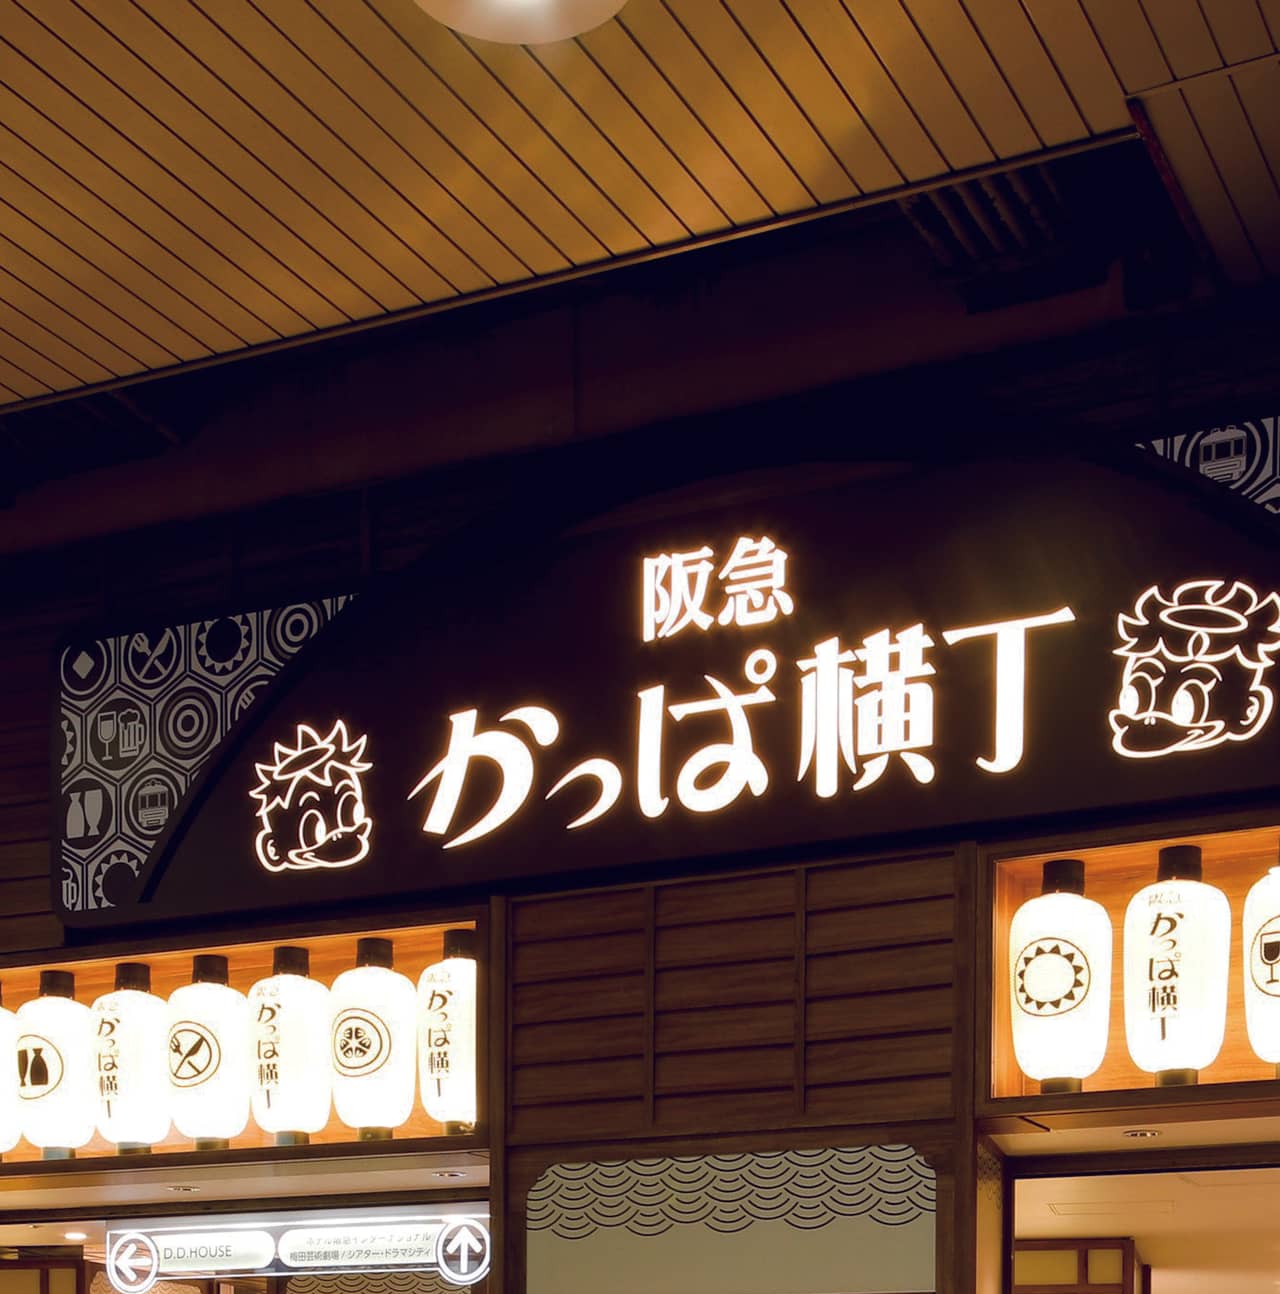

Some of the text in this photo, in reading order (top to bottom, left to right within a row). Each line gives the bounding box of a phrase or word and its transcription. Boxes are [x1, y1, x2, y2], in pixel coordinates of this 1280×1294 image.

[641, 536, 794, 642] 阪急
[407, 606, 1076, 849] かっぱ横丁
[1148, 911, 1185, 1041] かっぱ横丁
[163, 1245, 233, 1260] D.D.HOUSE
